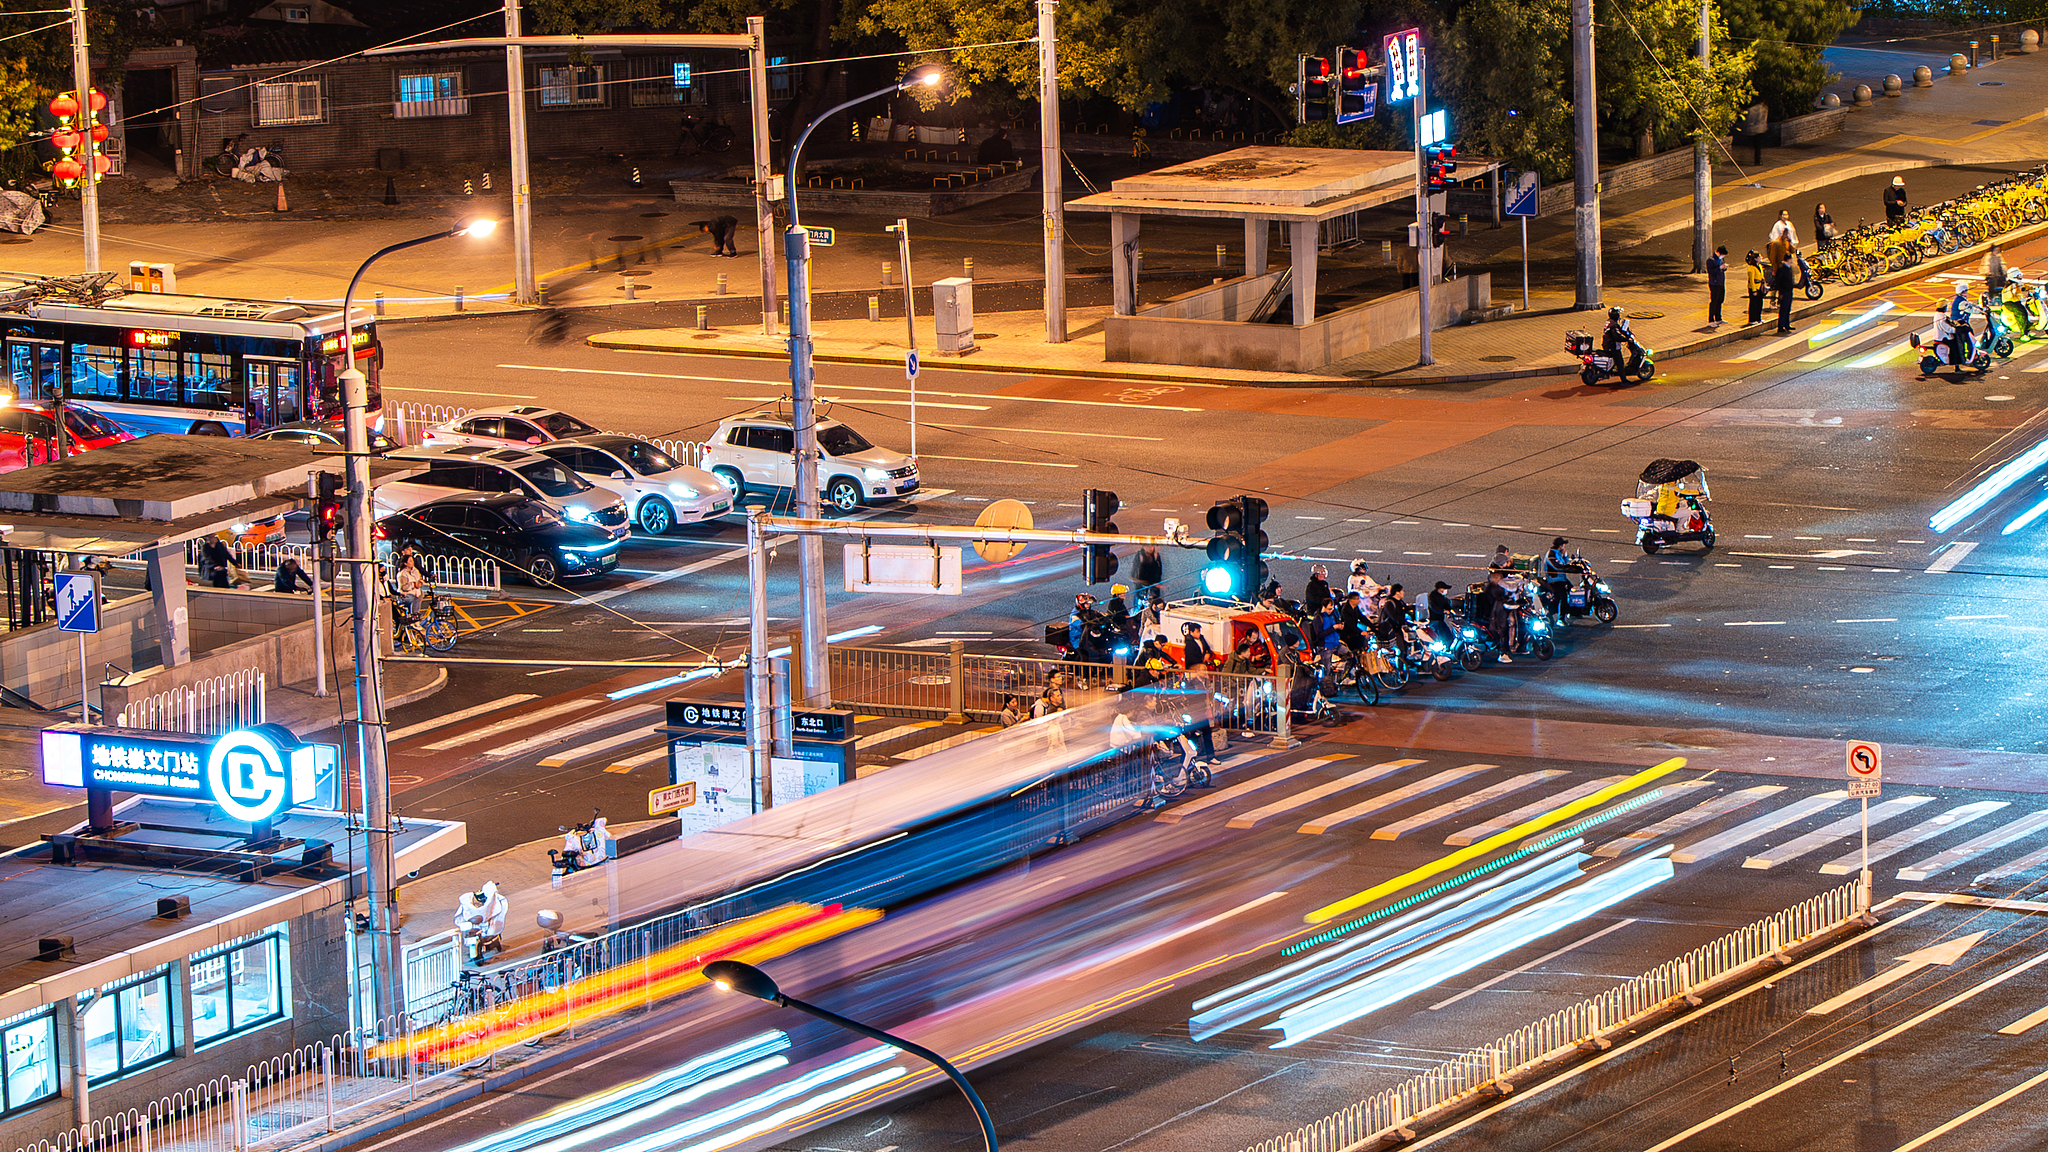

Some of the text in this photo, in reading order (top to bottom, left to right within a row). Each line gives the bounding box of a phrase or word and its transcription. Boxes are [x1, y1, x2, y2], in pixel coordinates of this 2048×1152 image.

[800, 716, 824, 727] 东北口
[92, 743, 199, 775] 地铁崇文门站
[93, 769, 169, 786] CHONGWENMEN
